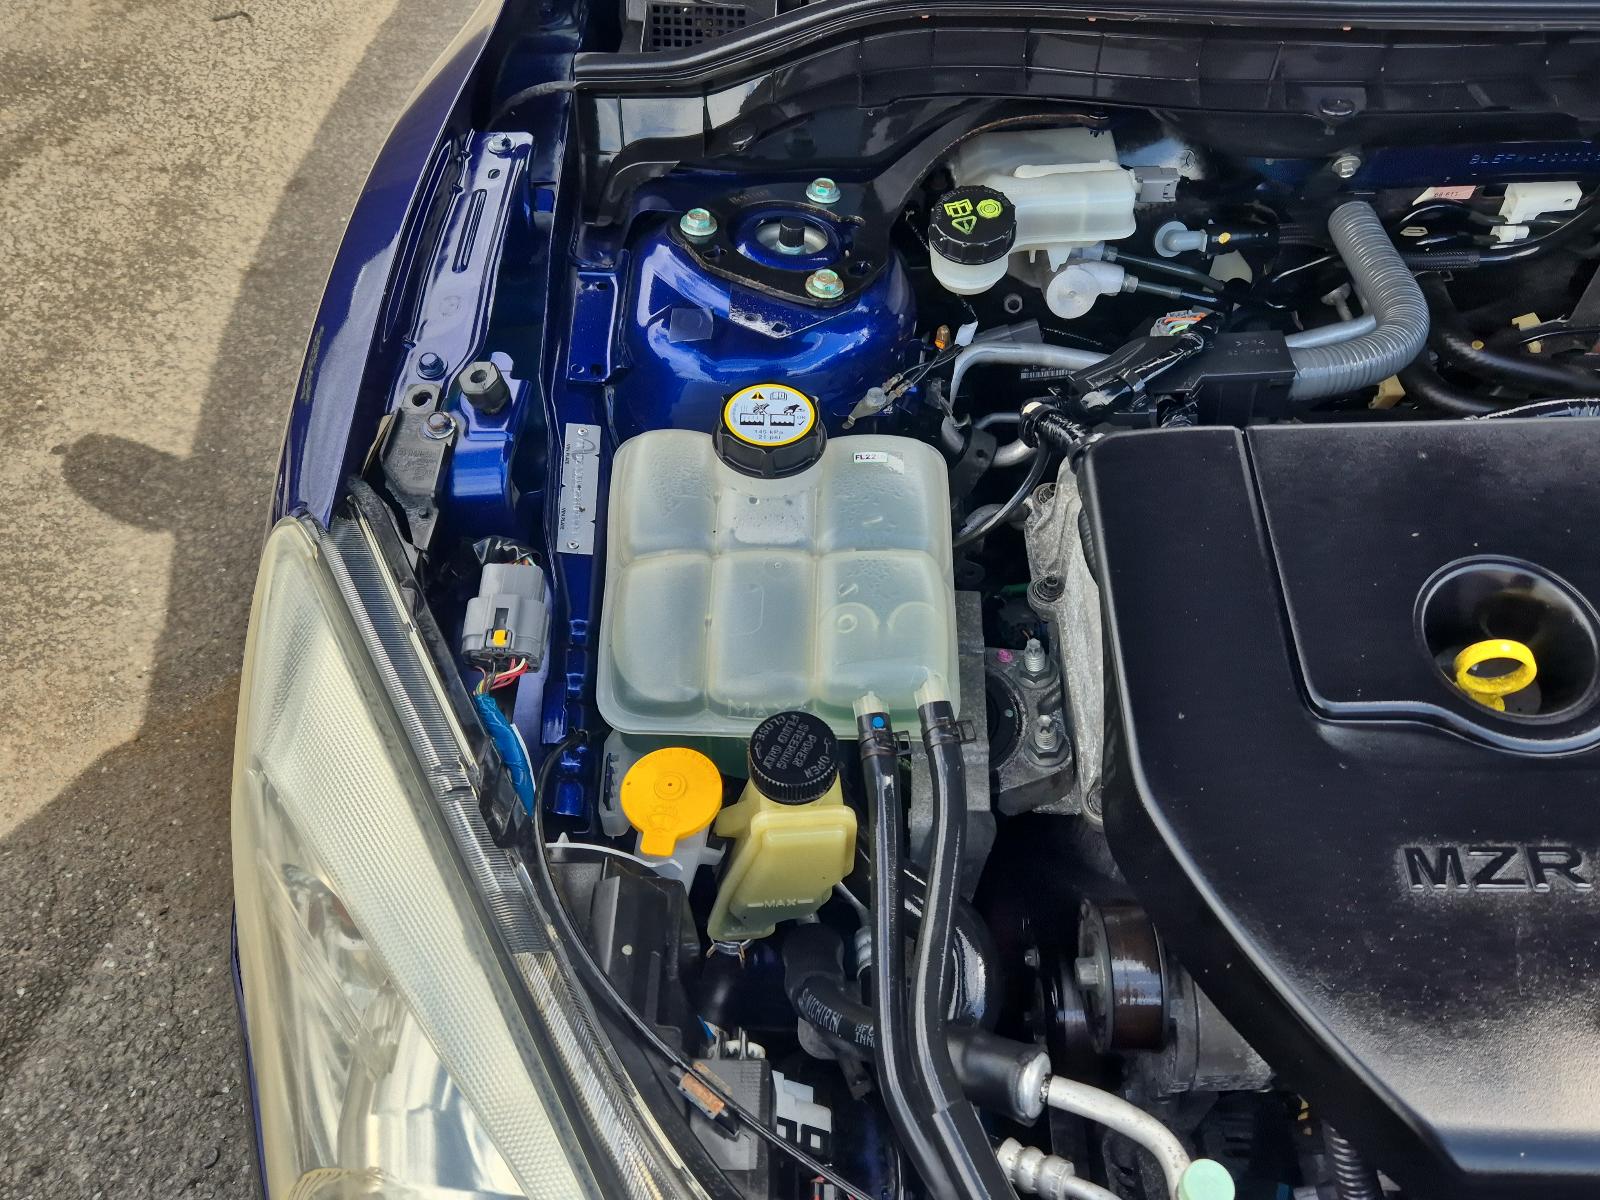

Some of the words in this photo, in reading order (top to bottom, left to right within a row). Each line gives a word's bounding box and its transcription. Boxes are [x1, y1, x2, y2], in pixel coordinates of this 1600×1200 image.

[755, 715, 786, 741] CLOSE
[777, 714, 800, 744] FLUID
[762, 744, 783, 770] ONLY
[776, 723, 810, 770] STEERING
[792, 734, 817, 768] POWER
[804, 755, 830, 779] OPEN
[1401, 845, 1594, 892] MZR
[764, 898, 797, 909] MAX
